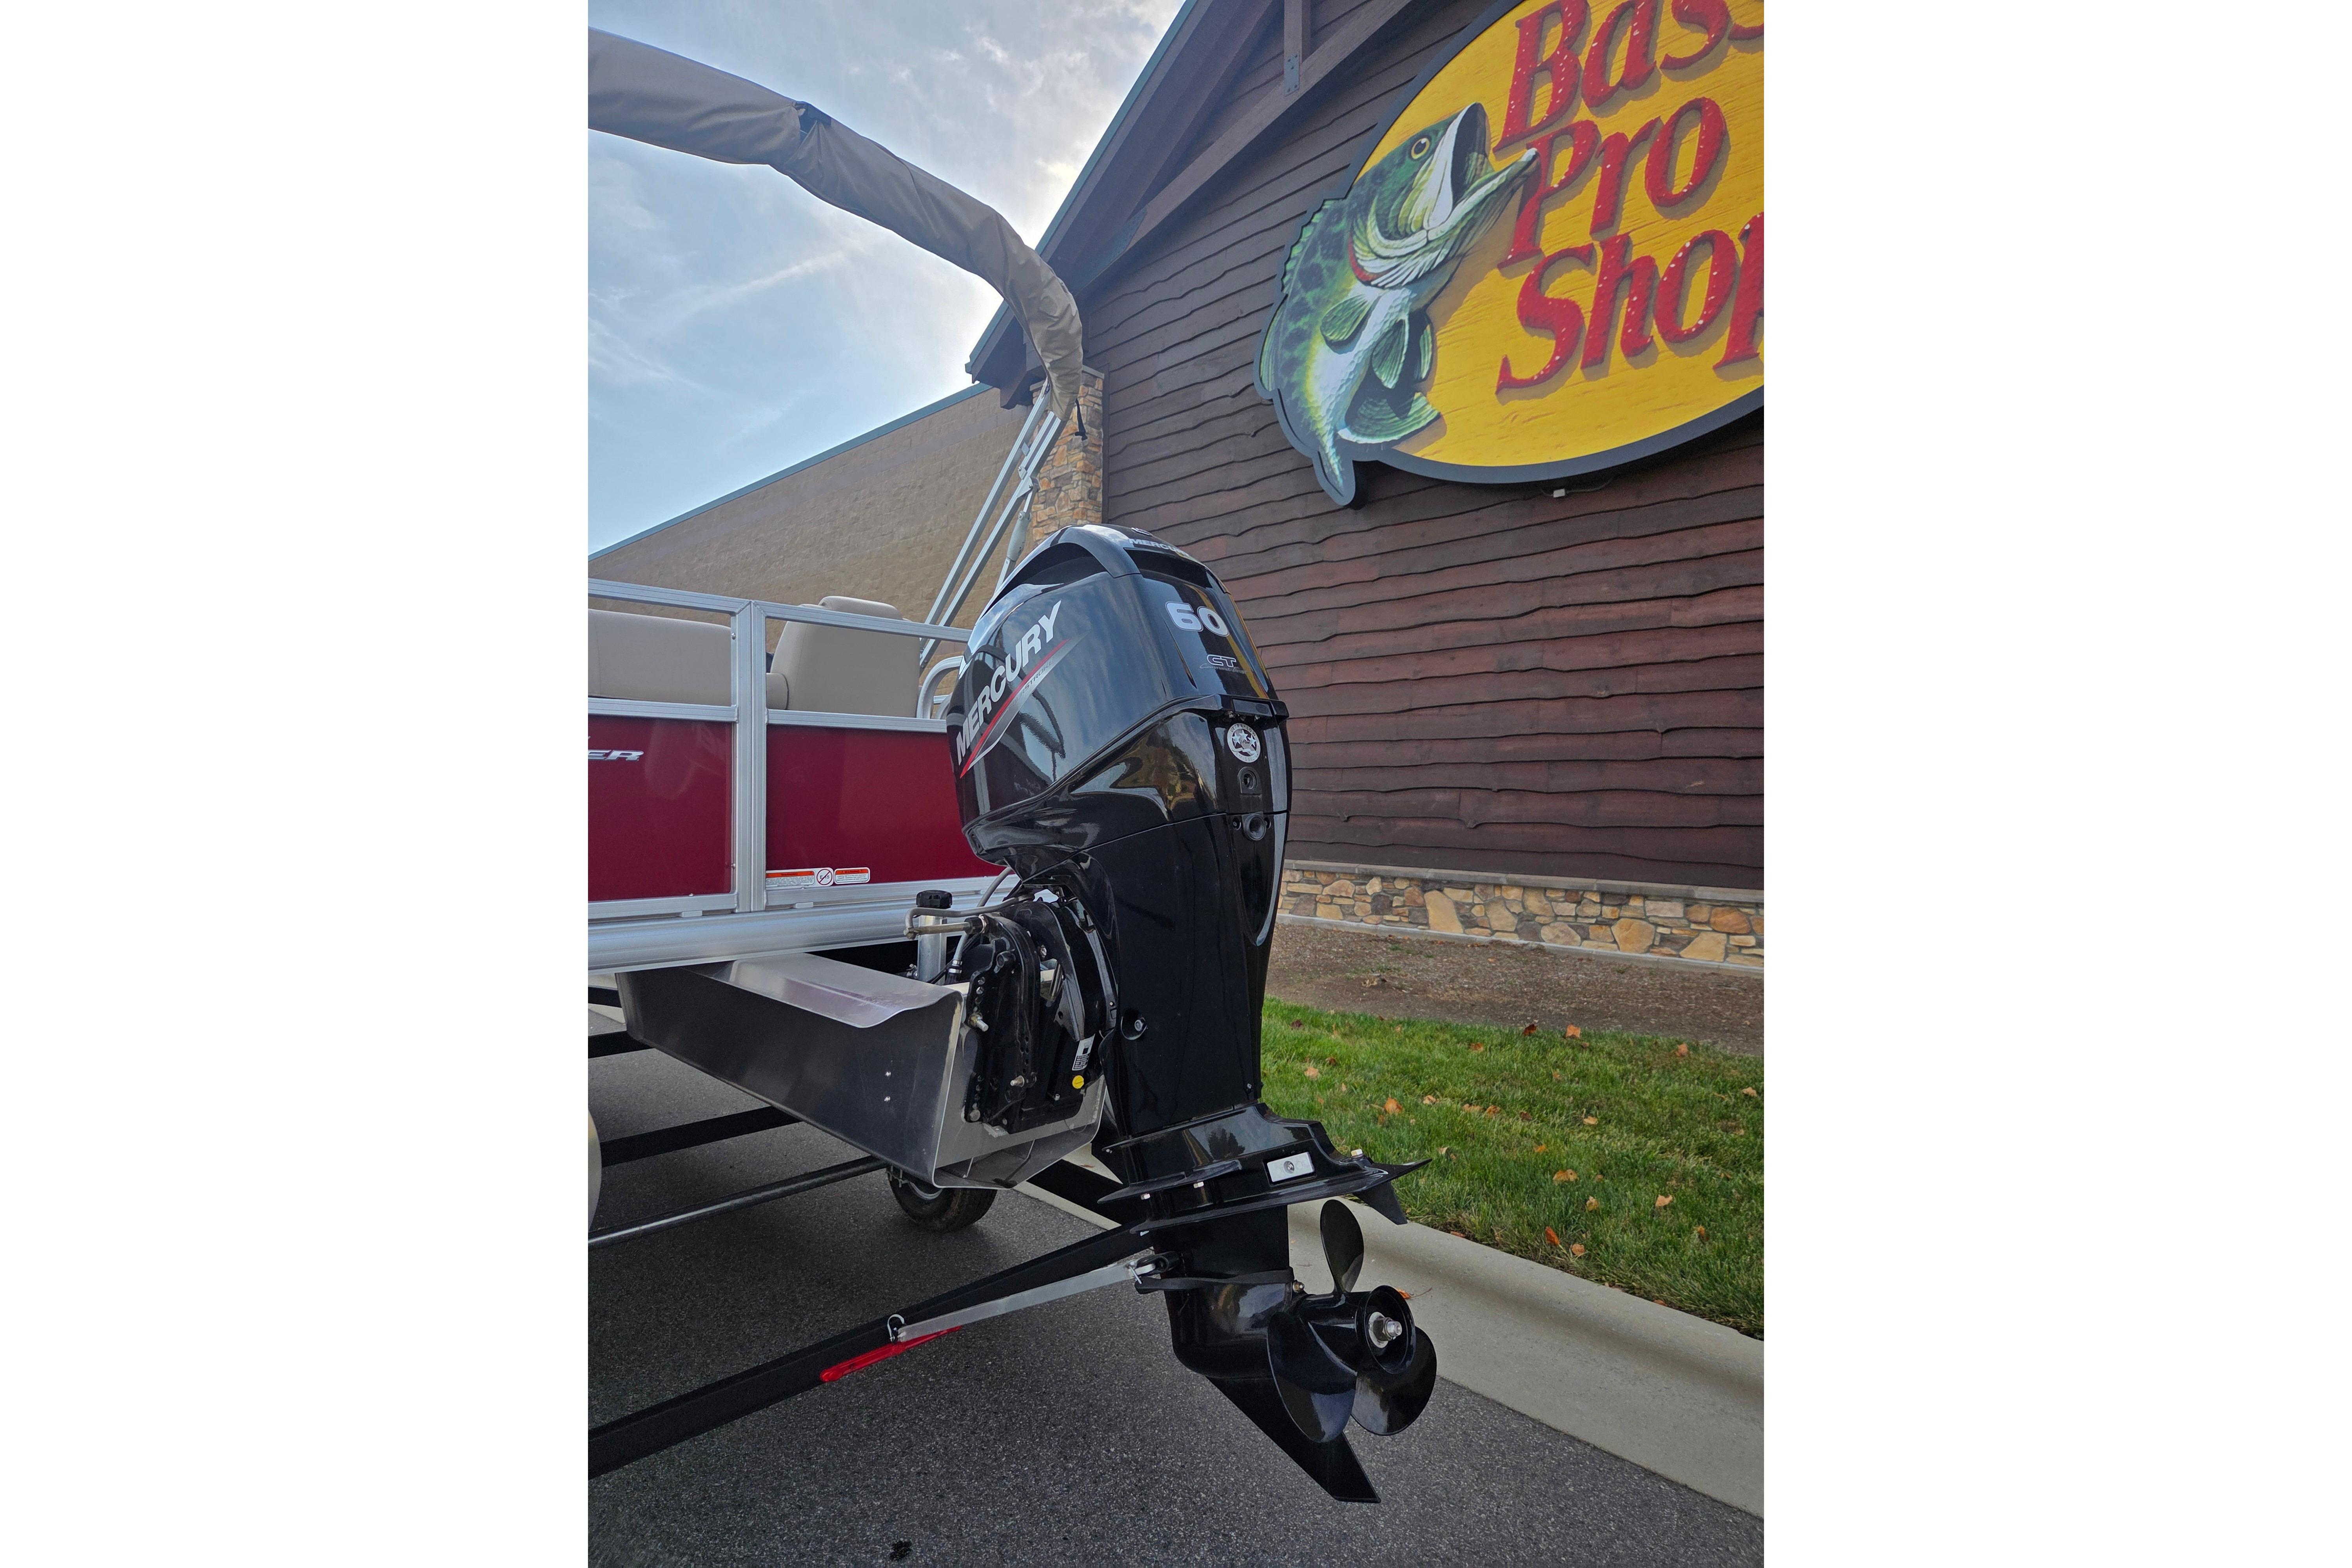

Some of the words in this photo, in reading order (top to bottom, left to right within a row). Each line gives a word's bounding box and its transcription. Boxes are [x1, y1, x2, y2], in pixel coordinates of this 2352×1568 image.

[1493, 0, 1764, 152] Bas
[1497, 97, 1727, 269] Pro
[1129, 538, 1190, 558] MERCU
[1165, 601, 1229, 637] 60
[1207, 654, 1237, 667] CT
[956, 600, 1062, 766] MERCURY
